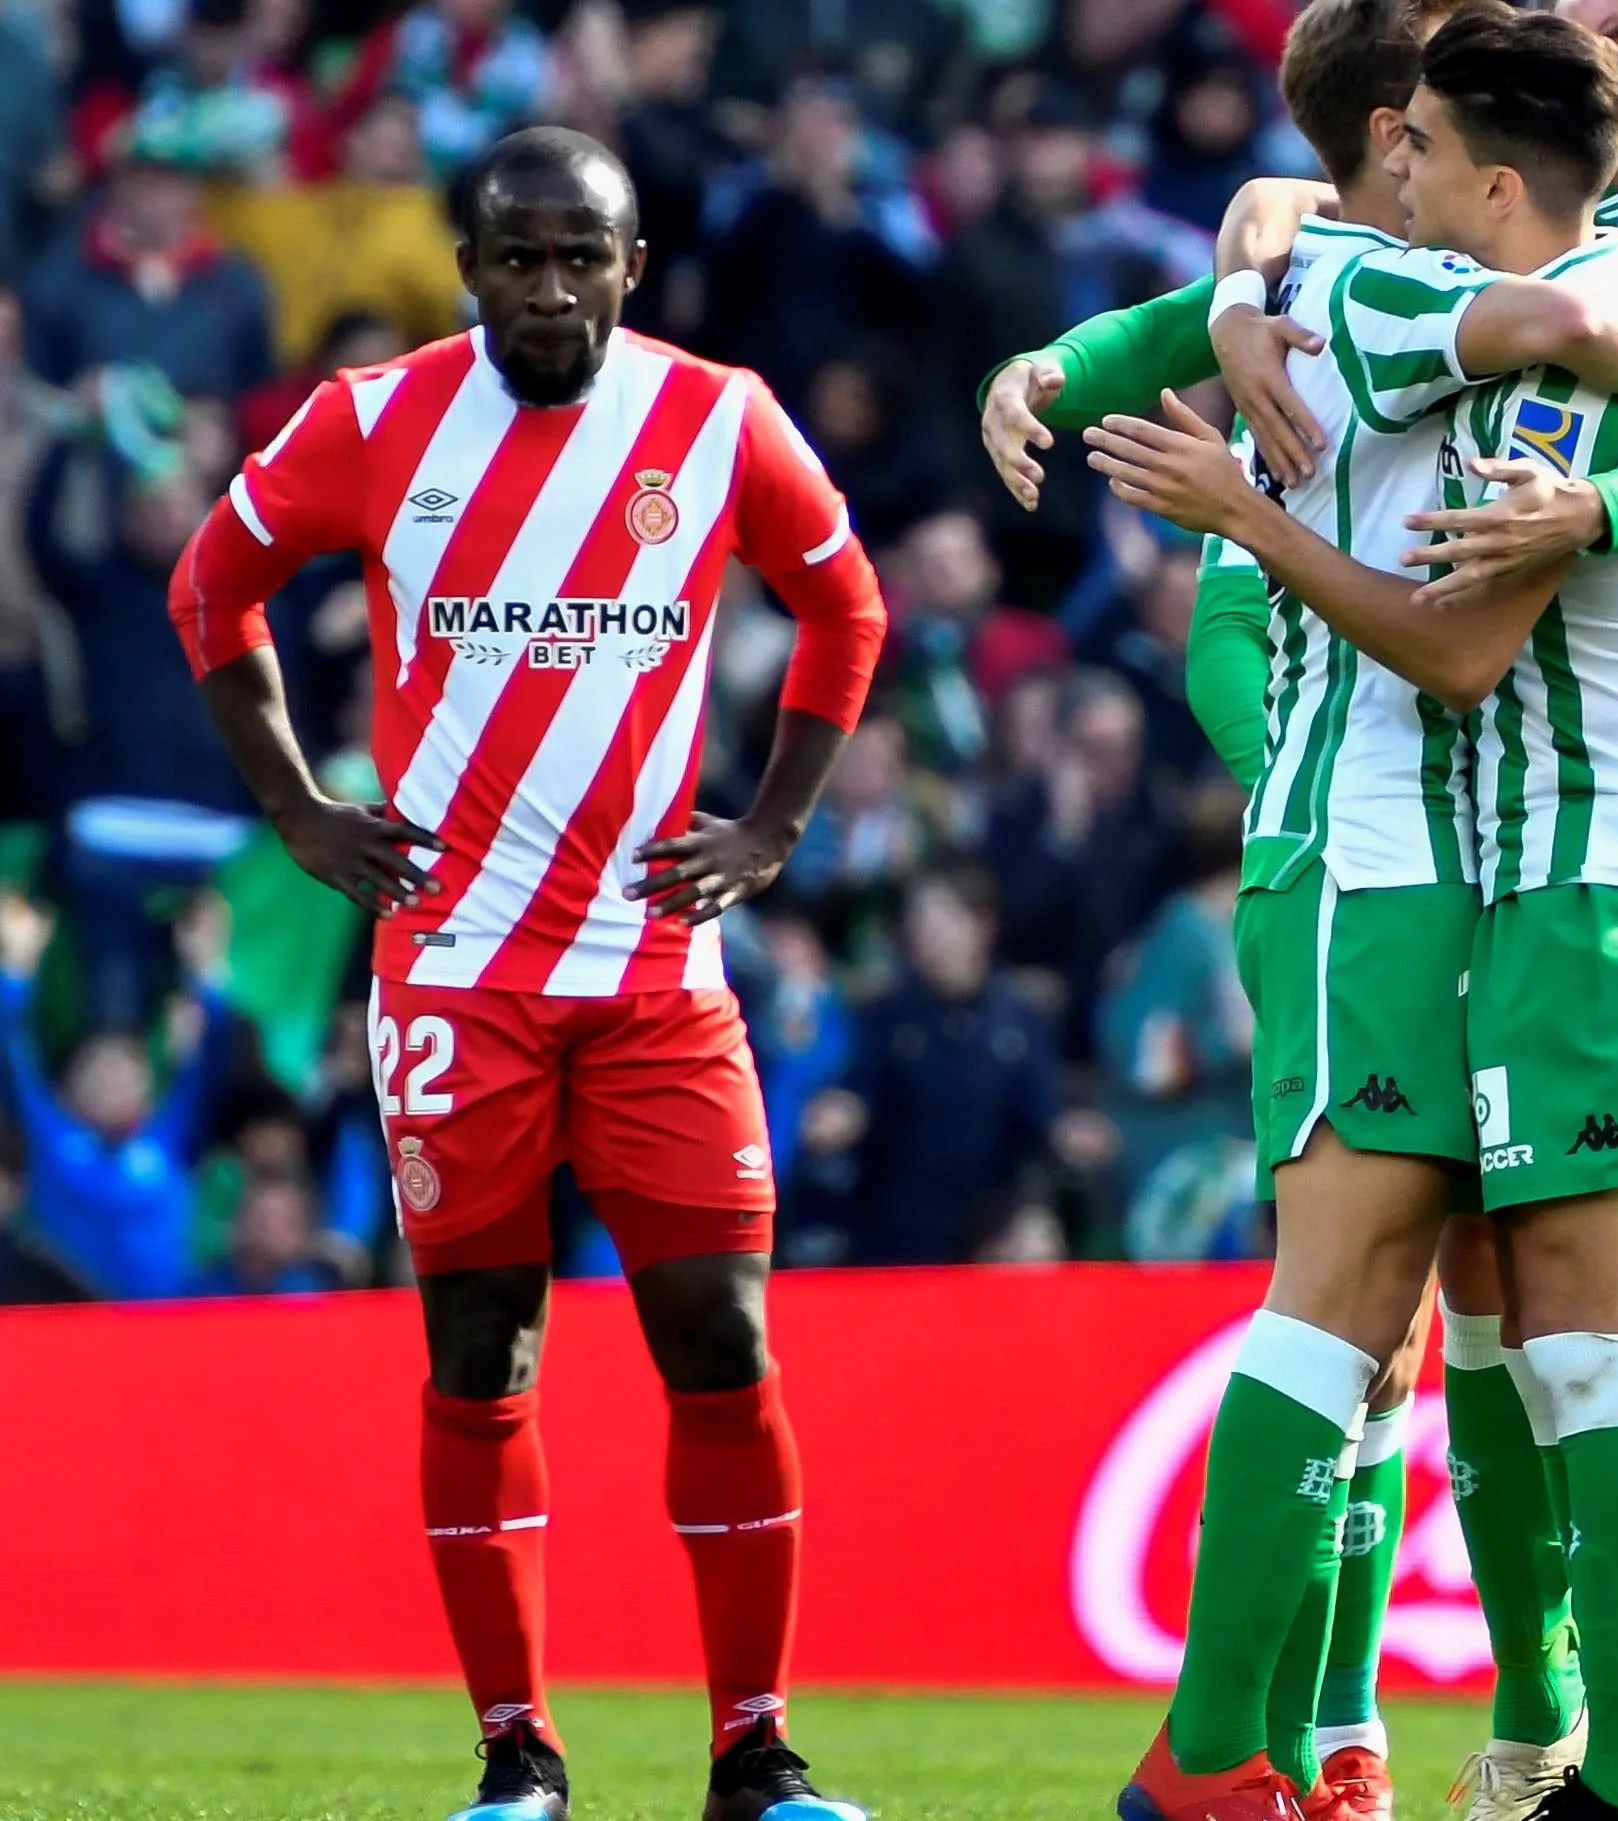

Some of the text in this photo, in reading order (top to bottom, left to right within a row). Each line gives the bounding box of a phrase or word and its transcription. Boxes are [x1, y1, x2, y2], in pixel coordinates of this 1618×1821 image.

[431, 599, 688, 639] MARATHON
[532, 645, 597, 666] BET
[376, 1015, 455, 1115] 22
